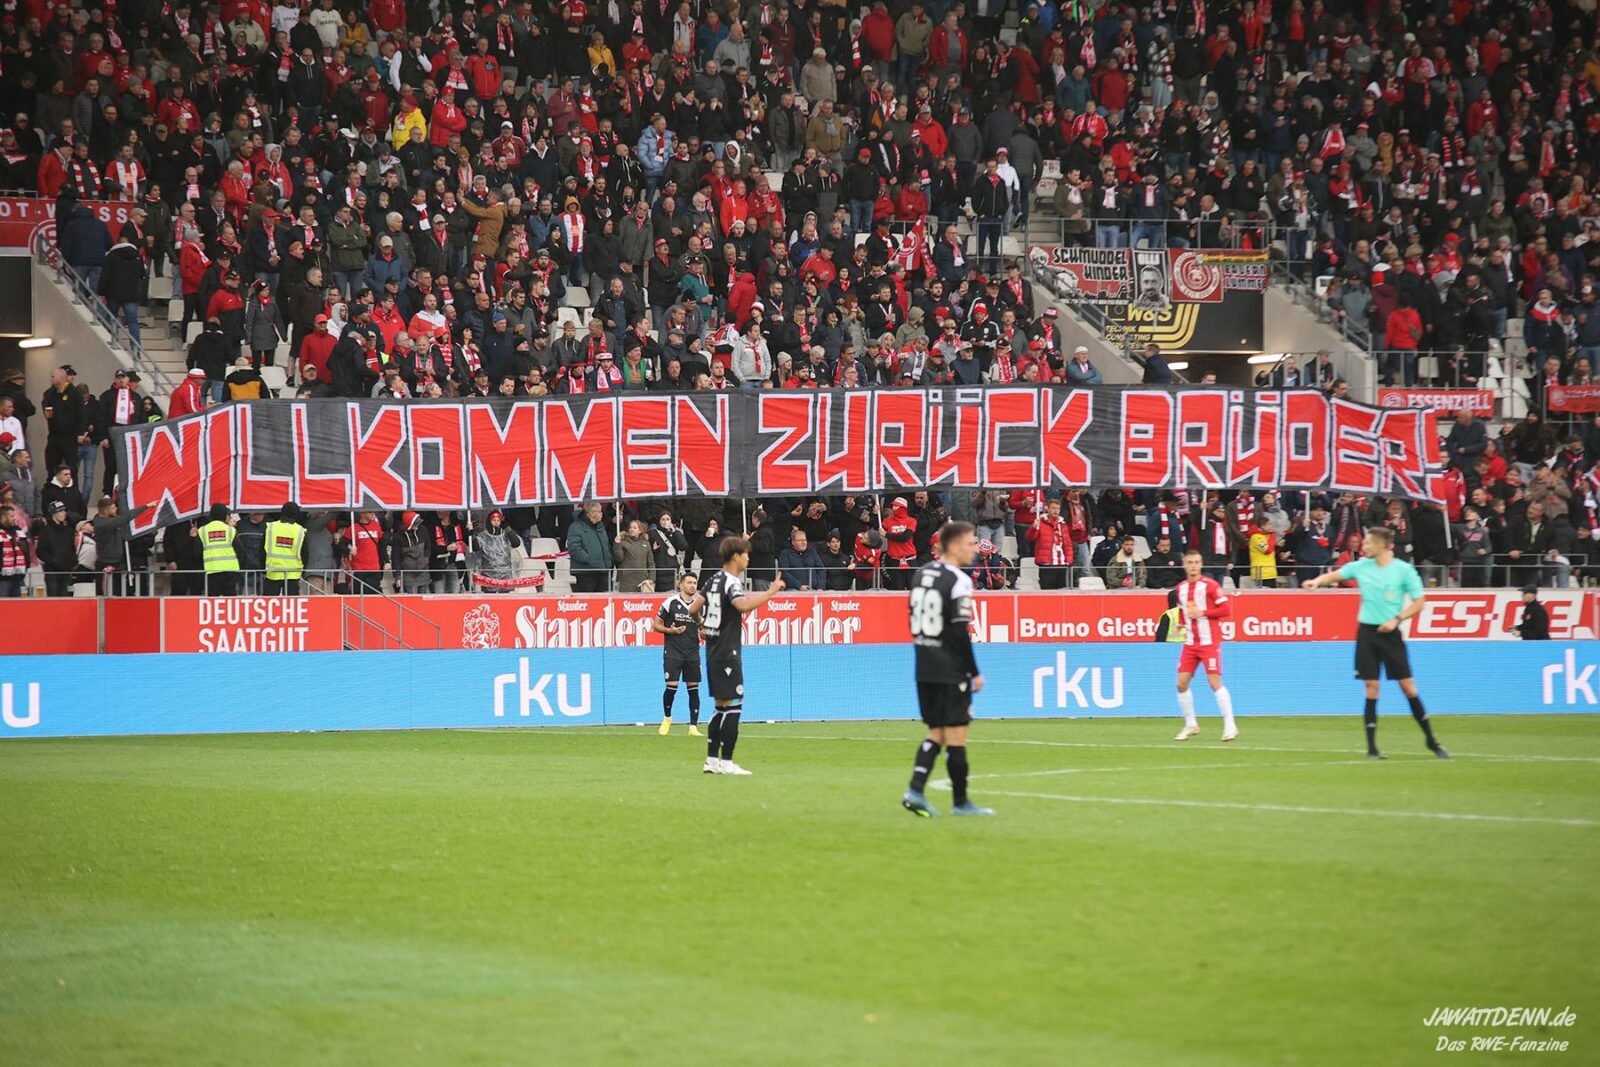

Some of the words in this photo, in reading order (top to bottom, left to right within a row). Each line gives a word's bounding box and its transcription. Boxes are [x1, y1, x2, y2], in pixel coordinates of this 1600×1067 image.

[1408, 394, 1491, 410] ESSENZIELL
[125, 393, 730, 536] WILLKOMMEN
[757, 388, 1094, 493] ZURÜCK
[1119, 389, 1447, 504] BRÜDER!
[199, 598, 309, 625] DEUTSCHE
[557, 600, 588, 612] Stauder
[623, 600, 654, 612] Stauder
[515, 602, 655, 648] Stauder
[740, 602, 861, 645] tauder
[1020, 618, 1090, 637] Bruno
[1242, 616, 1312, 636] GmbH
[199, 627, 309, 652] SAATGUT
[494, 657, 592, 717] rku
[1033, 650, 1124, 708] rku
